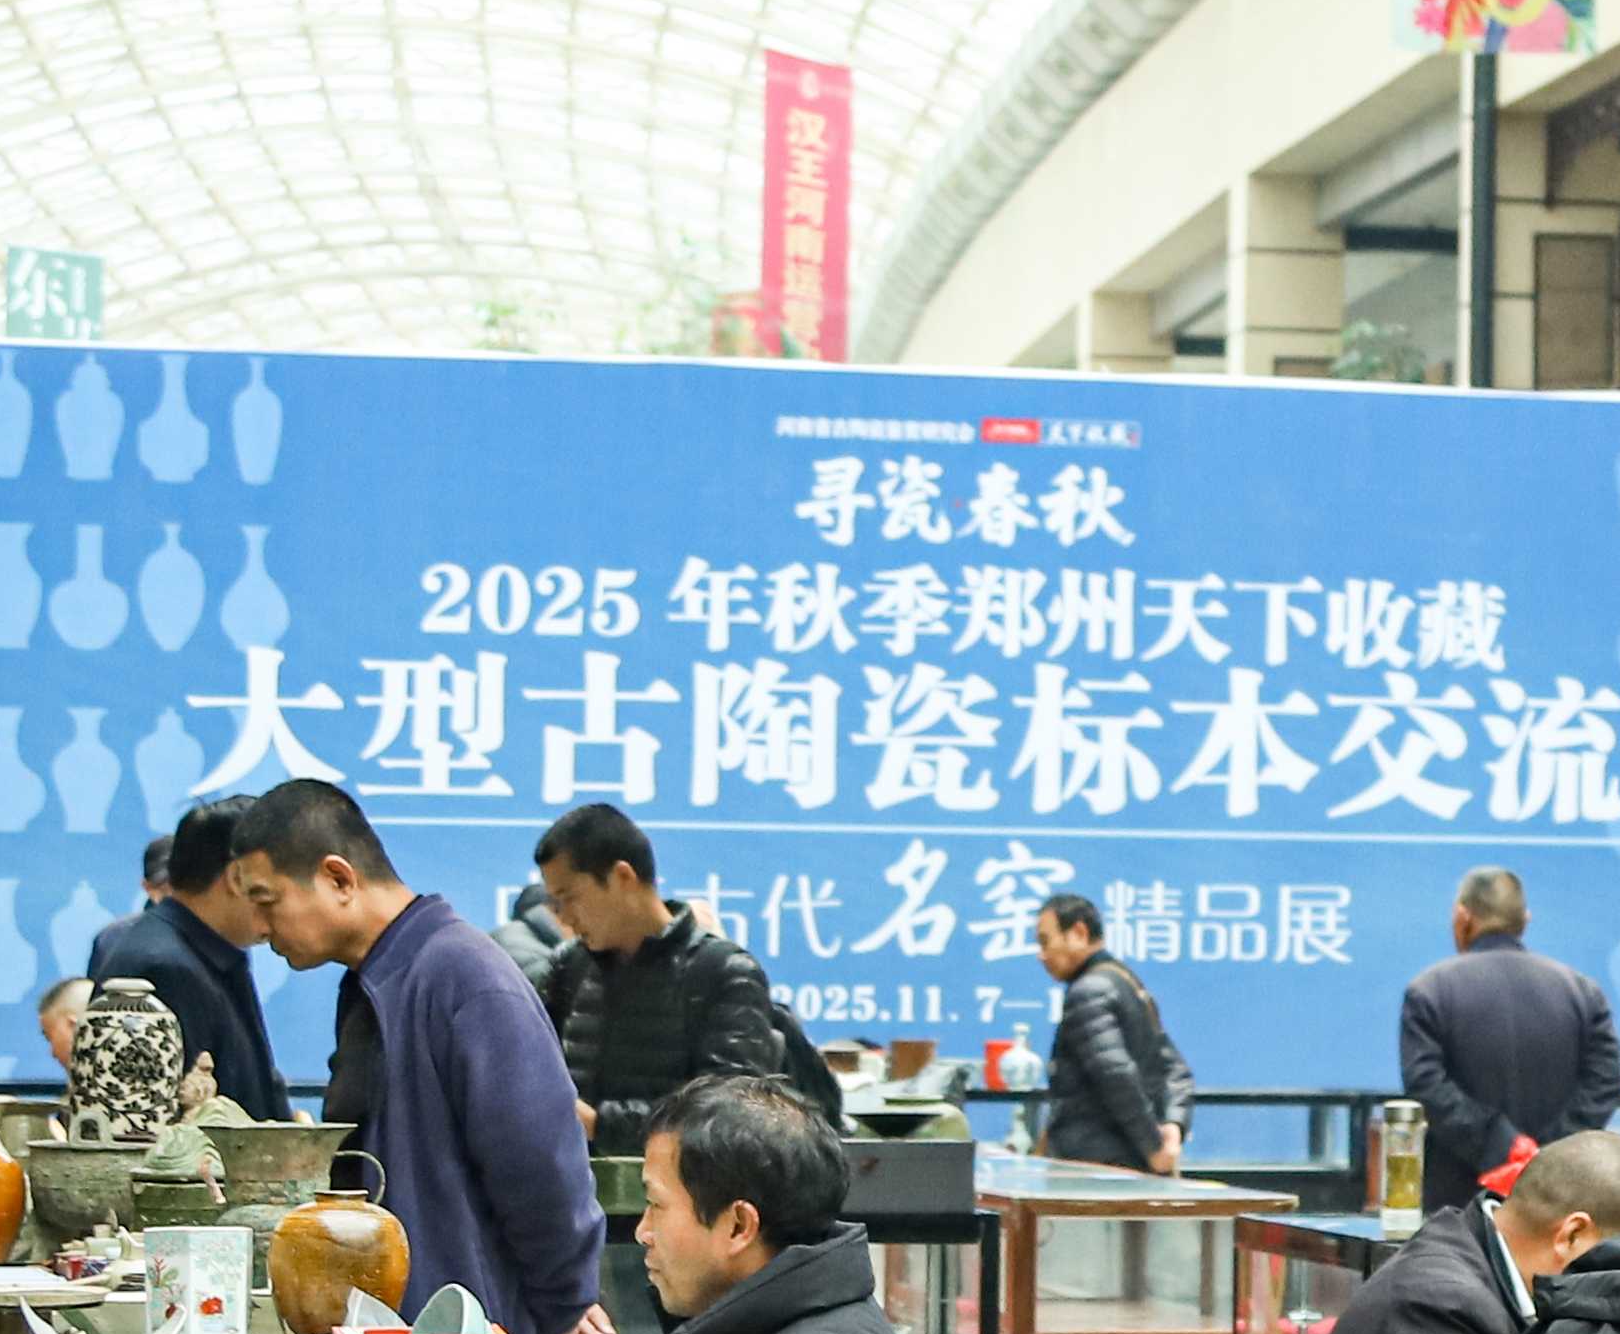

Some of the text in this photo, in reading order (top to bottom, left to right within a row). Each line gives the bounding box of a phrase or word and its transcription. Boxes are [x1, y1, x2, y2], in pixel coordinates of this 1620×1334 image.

[420, 556, 1507, 672] 2025 年秋季郑州天下收藏
